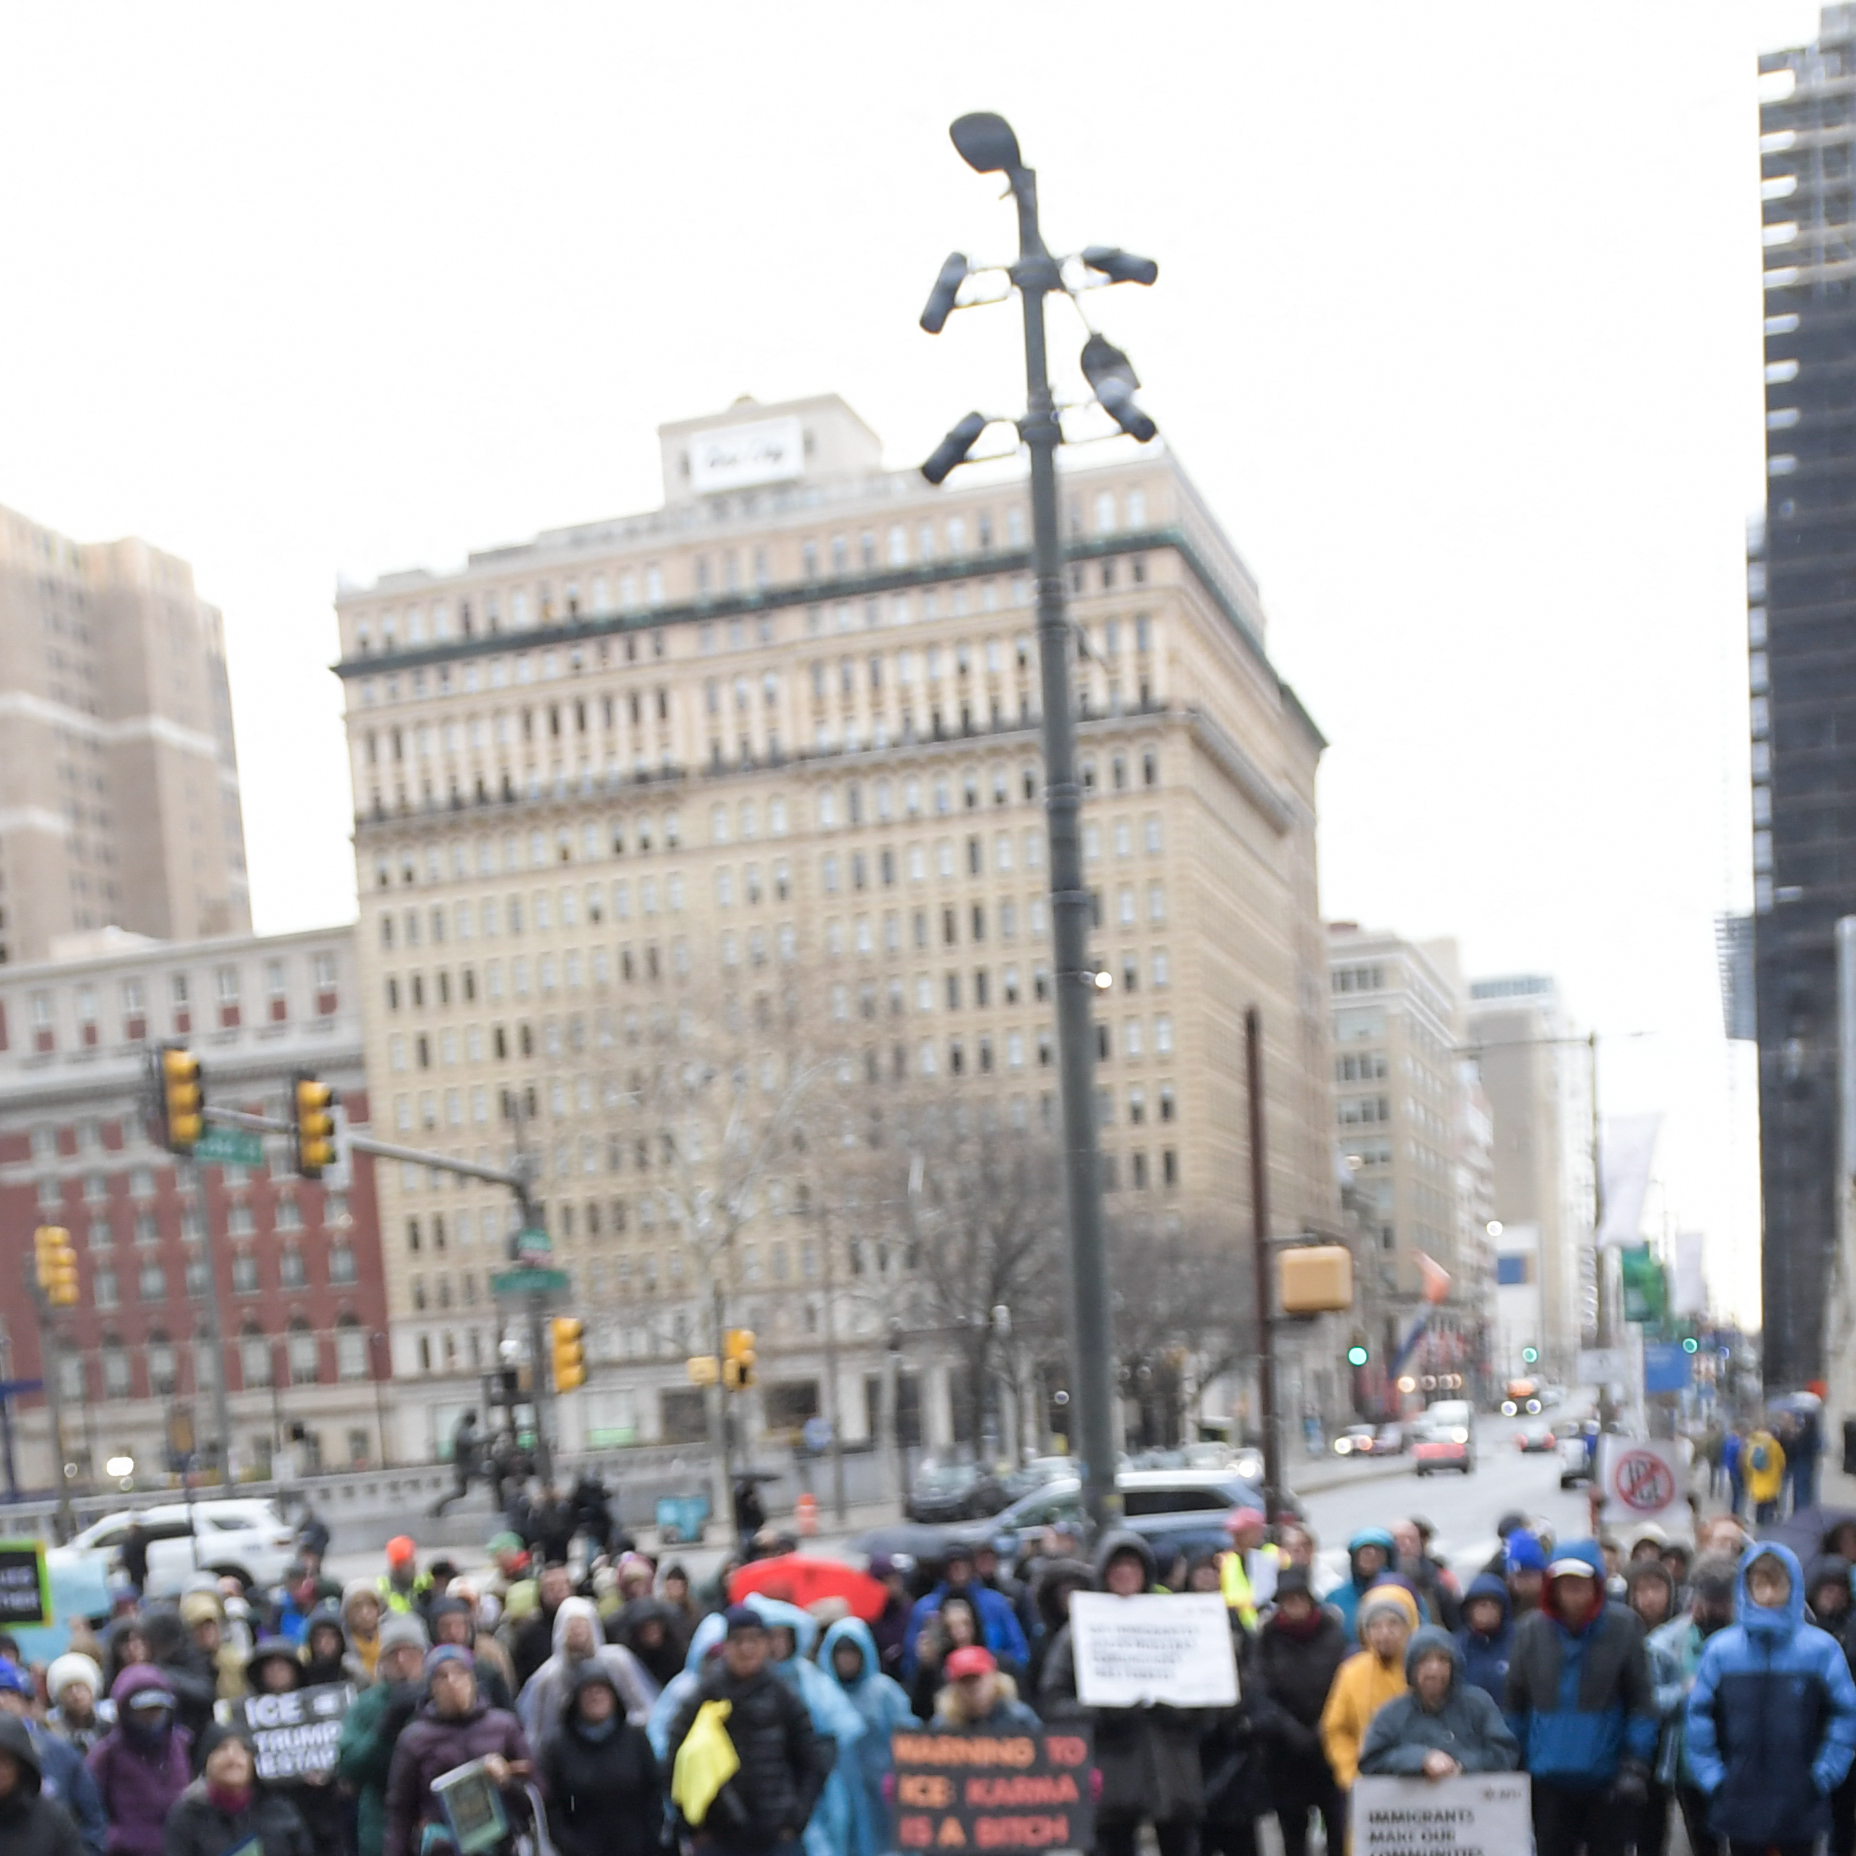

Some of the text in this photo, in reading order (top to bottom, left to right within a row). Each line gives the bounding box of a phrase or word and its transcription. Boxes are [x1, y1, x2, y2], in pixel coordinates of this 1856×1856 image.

[245, 1691, 303, 1728] ICE
[892, 1734, 1088, 1767] WARNING TO
[965, 1773, 1080, 1807] KARMA
[899, 1814, 1070, 1848] IS A BITCH
[1368, 1809, 1475, 1825] IMMIGRANTS
[1369, 1828, 1456, 1844] MAKE OUR
